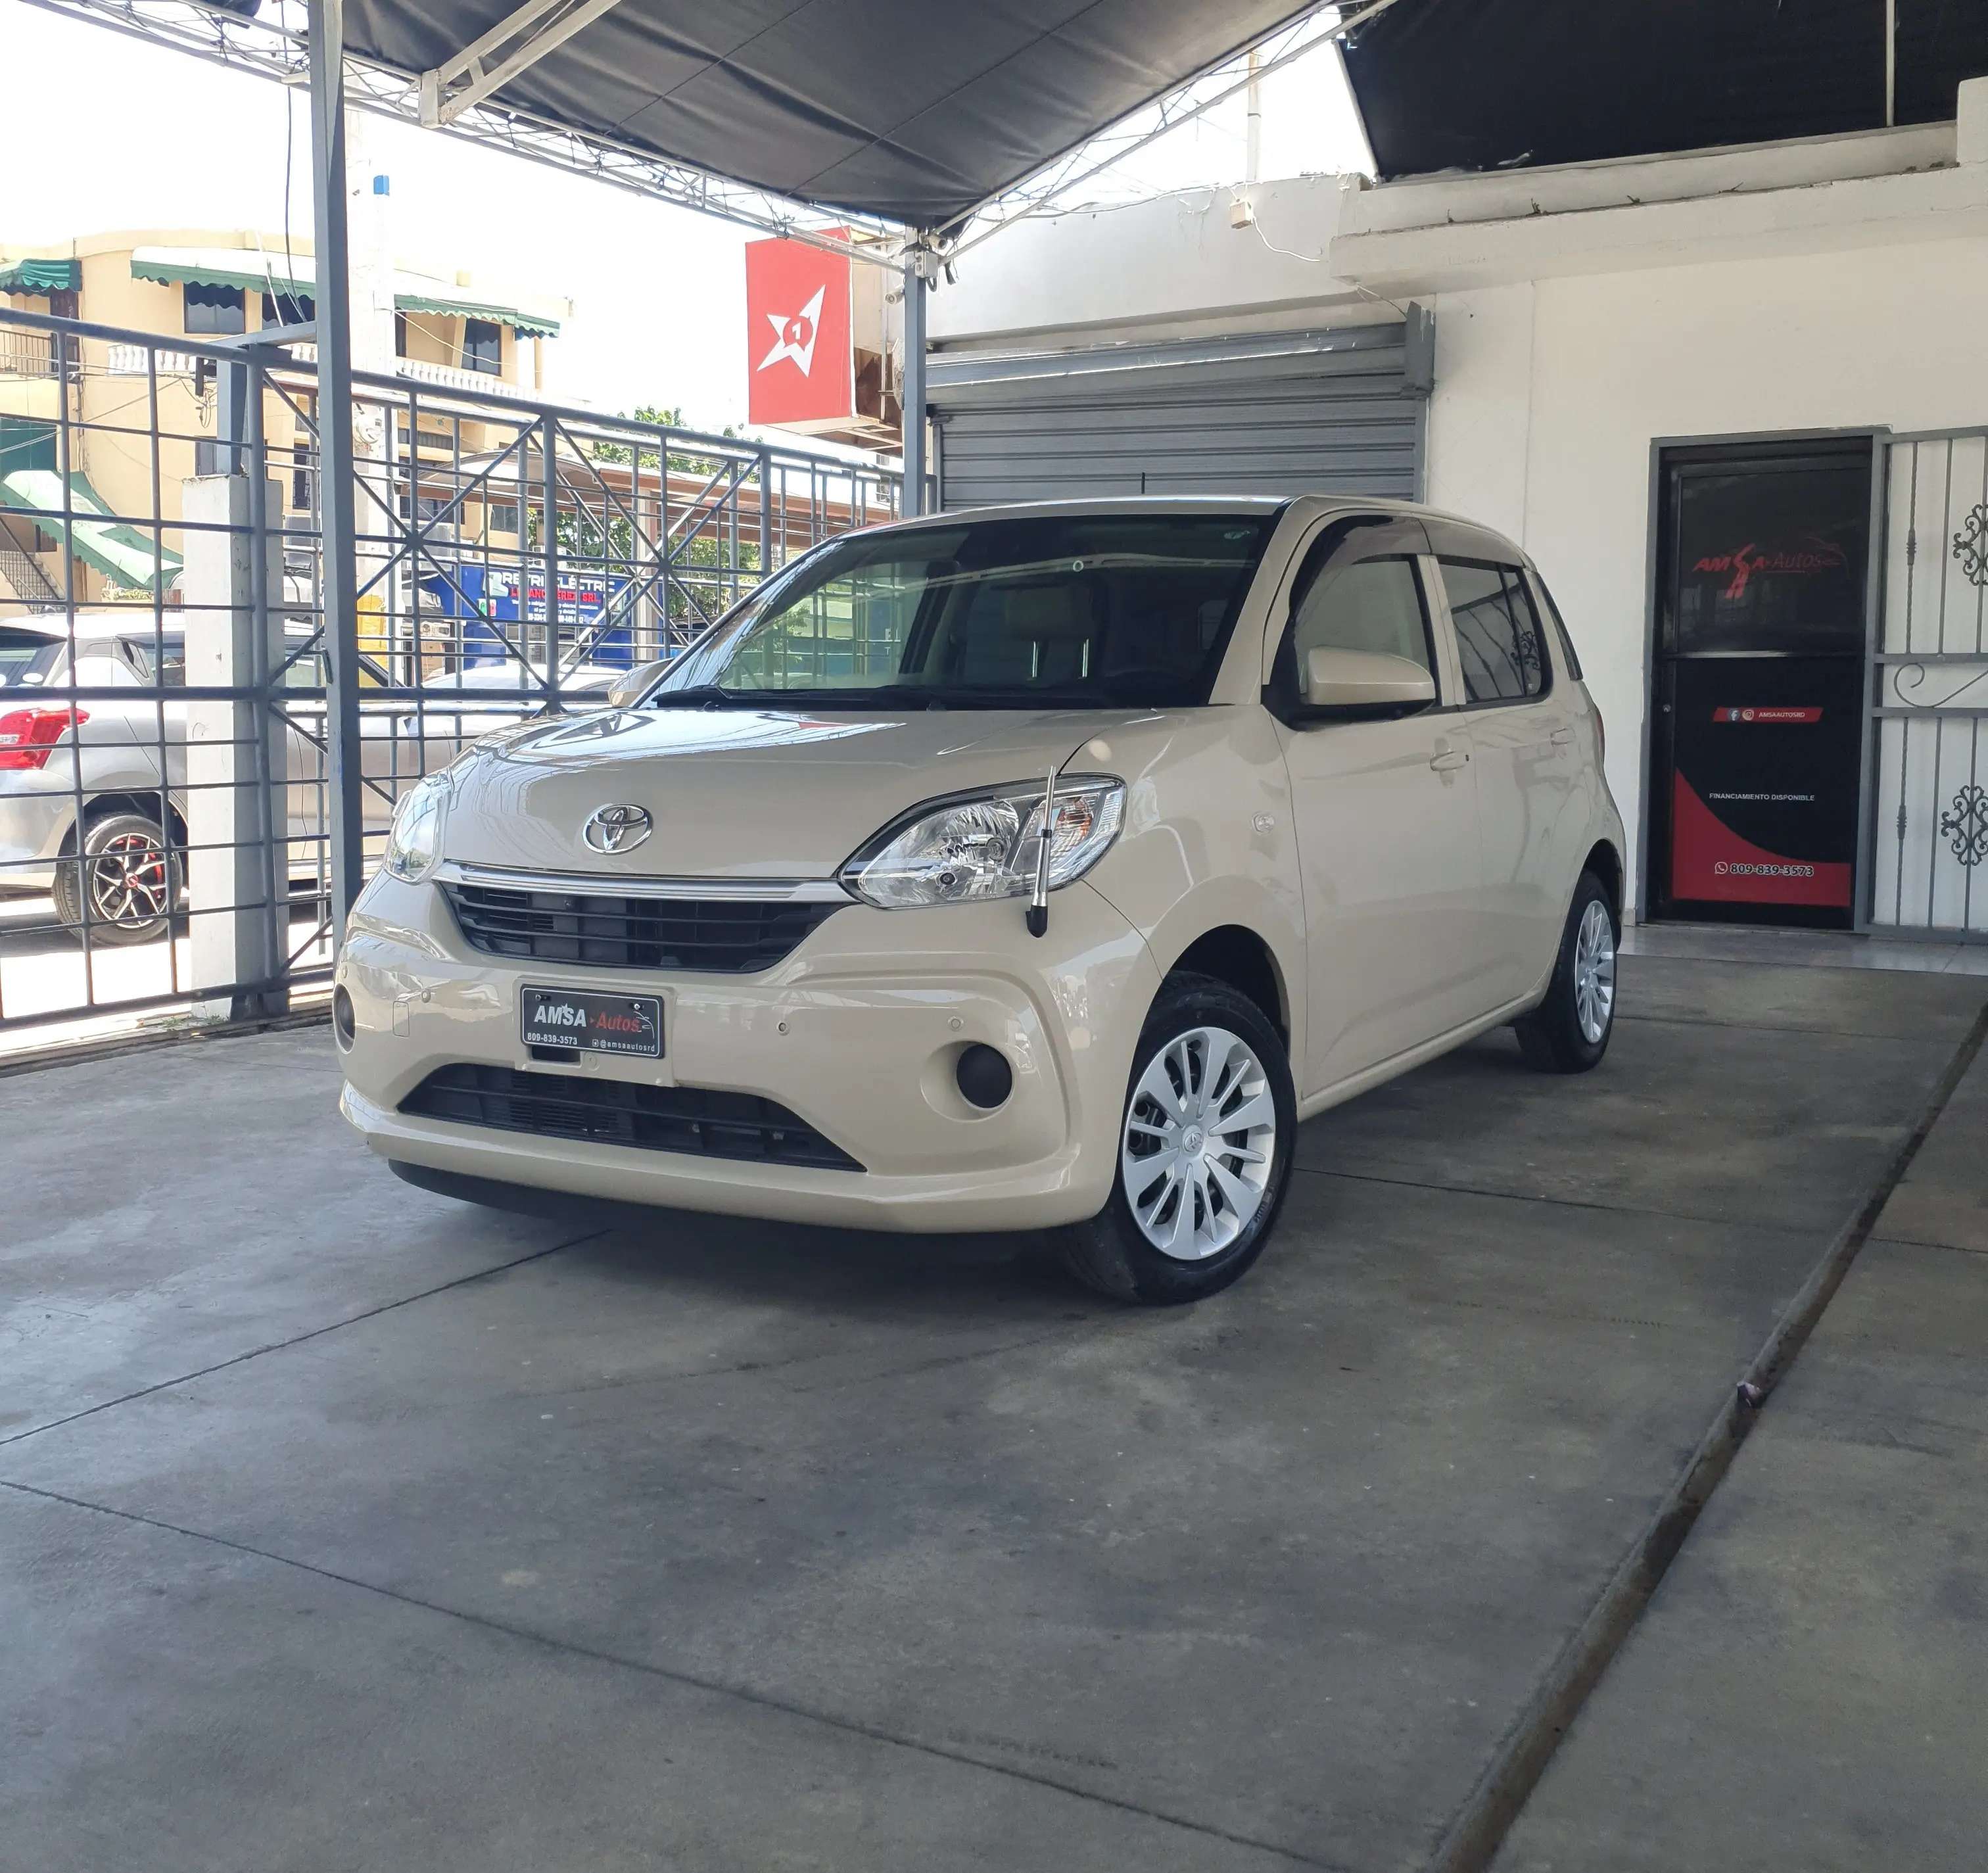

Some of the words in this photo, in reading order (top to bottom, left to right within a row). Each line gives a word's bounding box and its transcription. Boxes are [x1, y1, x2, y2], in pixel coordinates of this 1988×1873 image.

[792, 321, 801, 340] 1
[1730, 863, 1814, 877] 809-839-3573
[534, 1005, 587, 1028] AMSA
[596, 1011, 642, 1033] Autos
[527, 1032, 578, 1045] 809-839-3573
